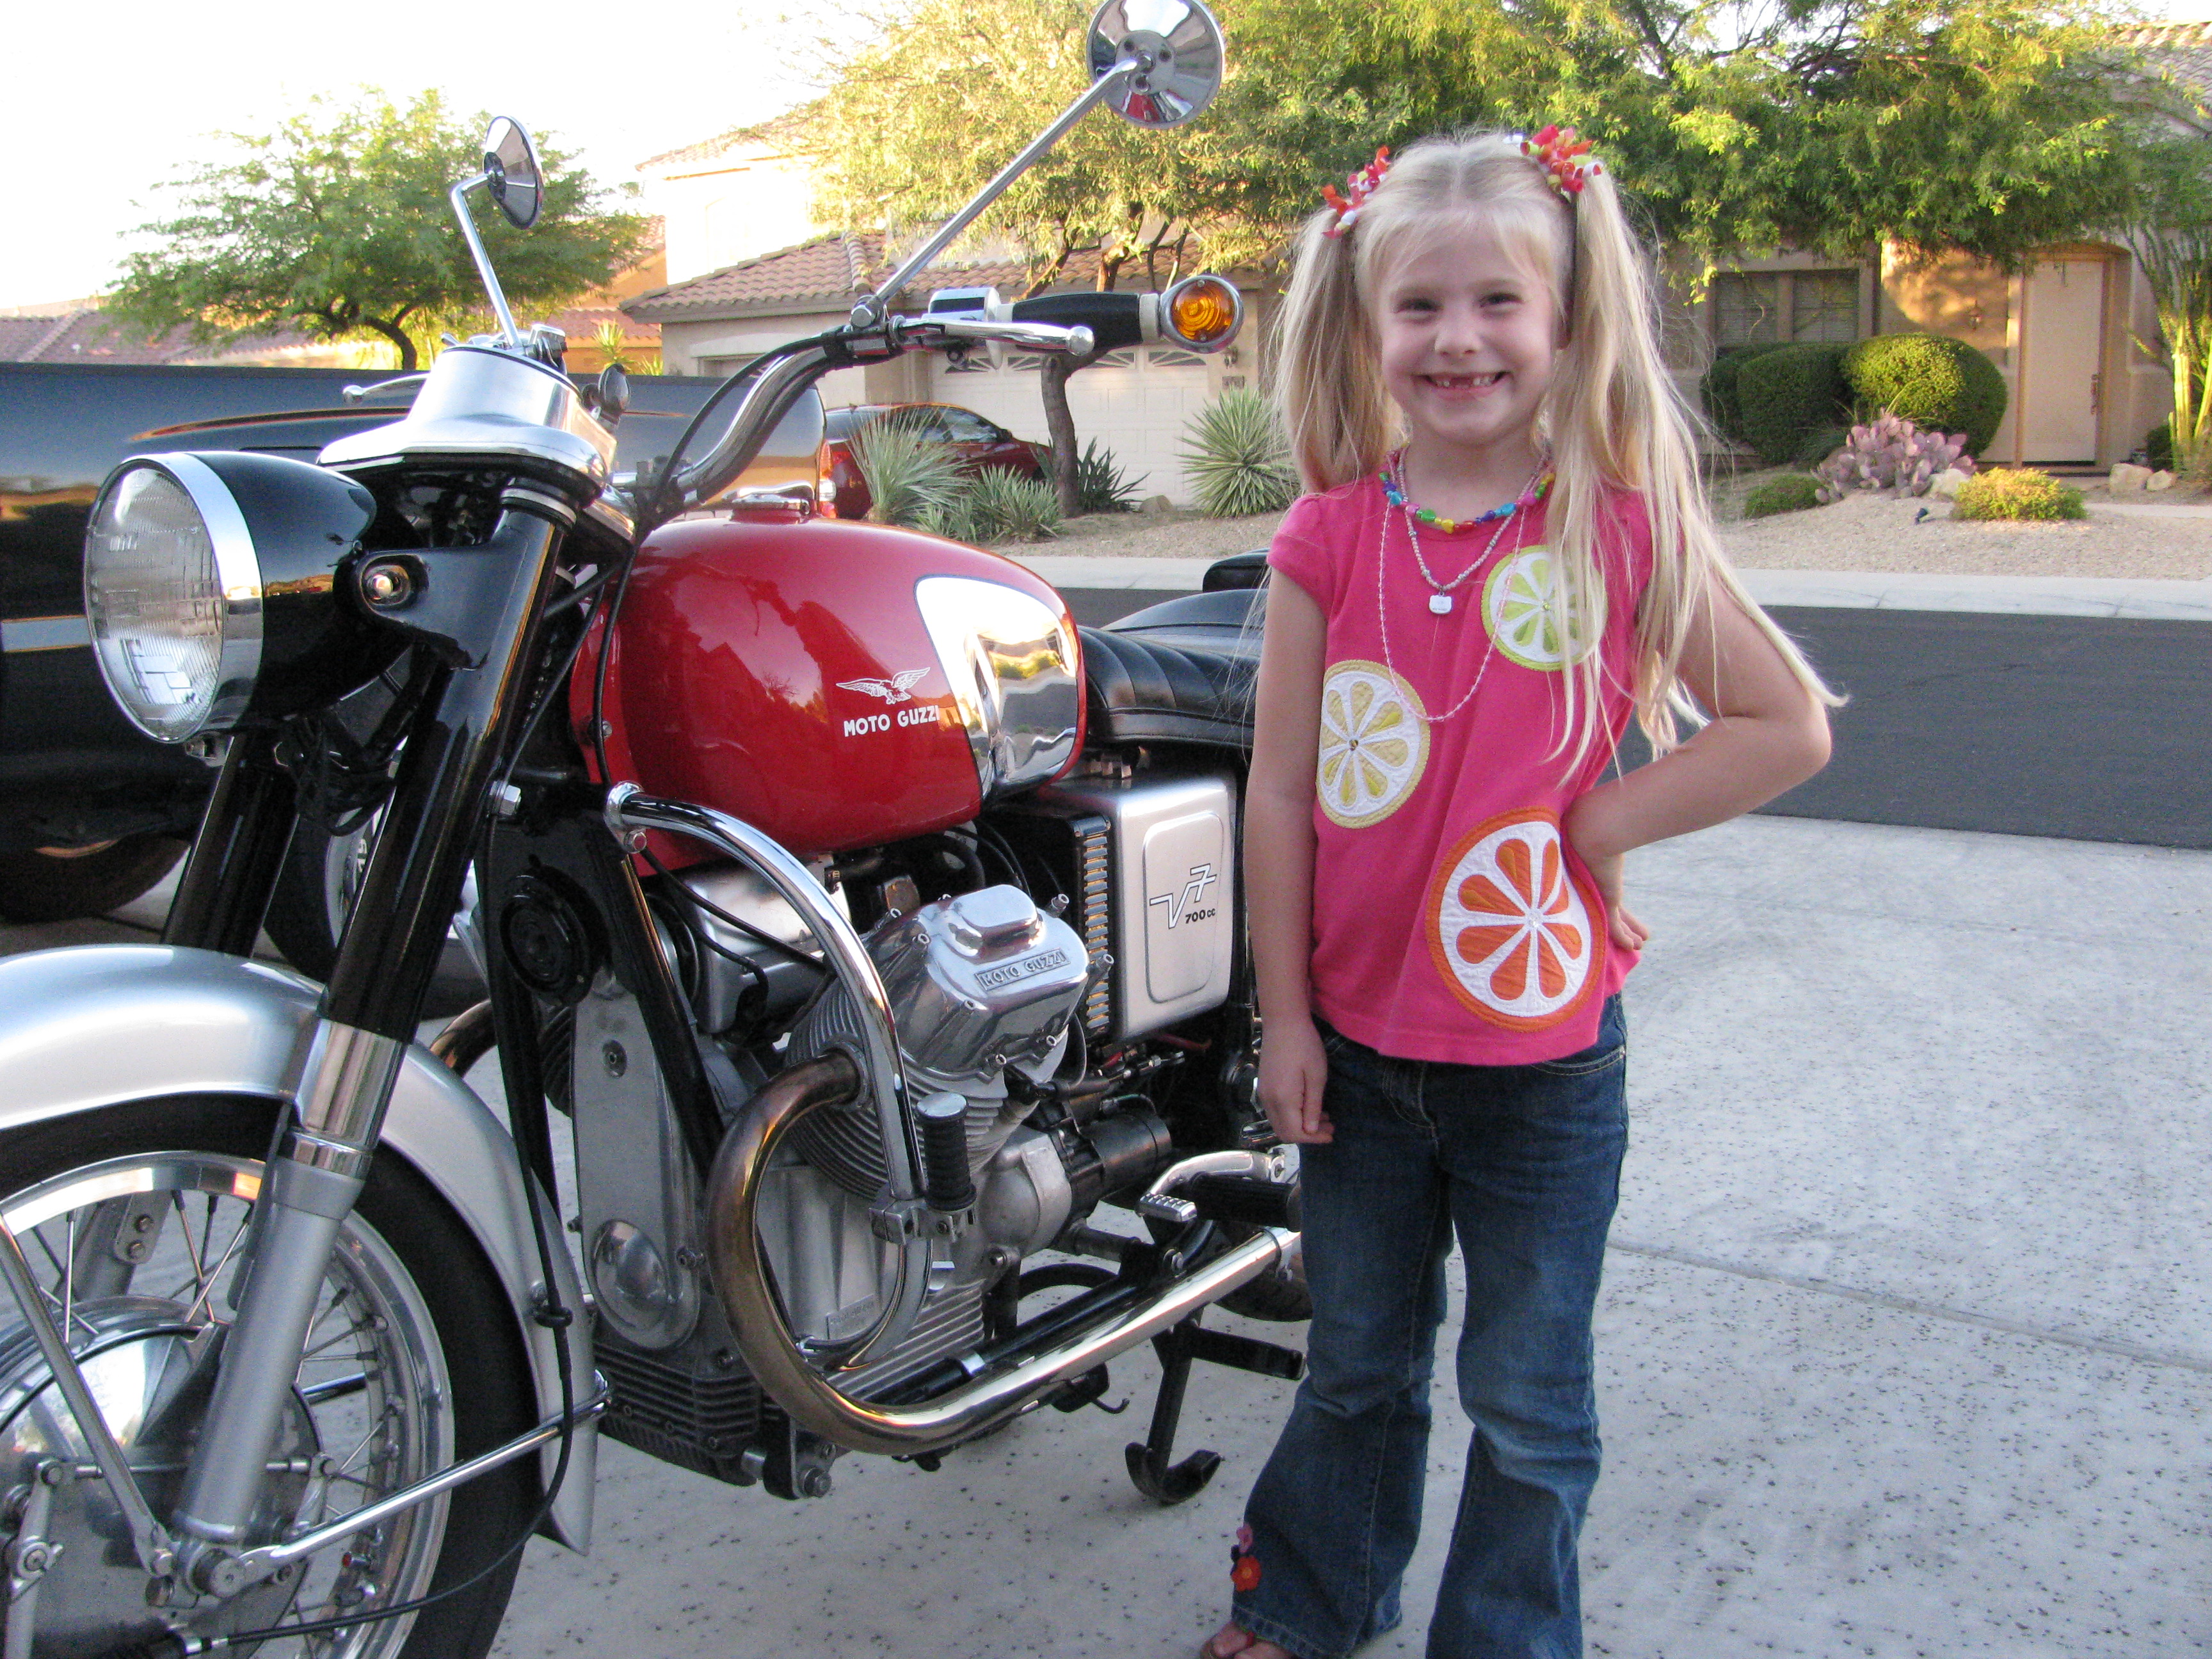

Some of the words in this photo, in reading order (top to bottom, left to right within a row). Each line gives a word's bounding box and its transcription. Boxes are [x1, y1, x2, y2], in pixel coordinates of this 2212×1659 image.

[844, 714, 890, 737] MOTO
[897, 705, 940, 727] GUZZI
[1150, 863, 1217, 929] V7
[981, 966, 1021, 986] MOTO
[1024, 952, 1066, 972] GUZZI
